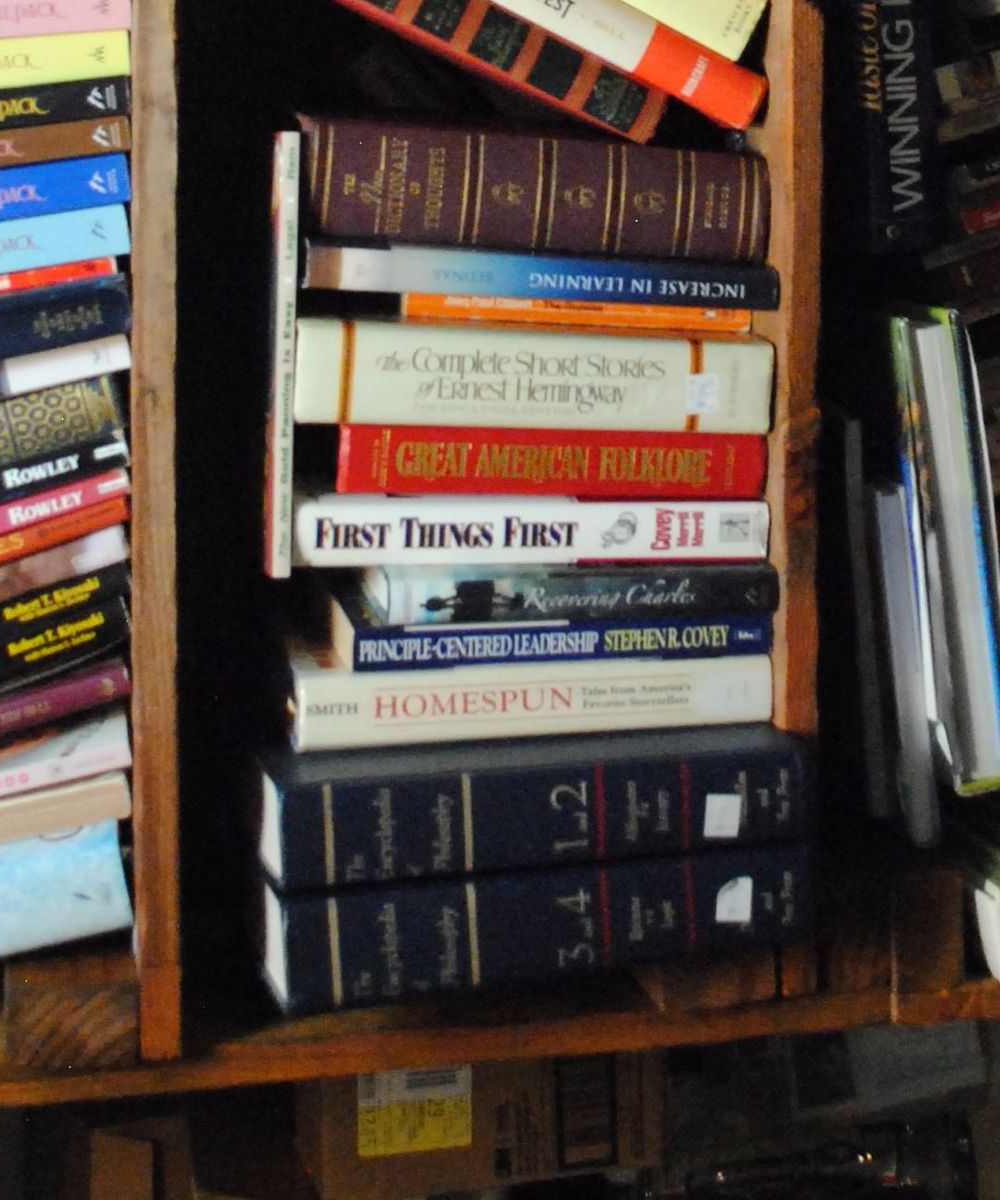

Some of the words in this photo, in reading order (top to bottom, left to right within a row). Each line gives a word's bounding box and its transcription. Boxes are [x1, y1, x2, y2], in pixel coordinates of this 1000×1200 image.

[881, 17, 924, 214] WINNING
[529, 272, 624, 294] LEARNING
[627, 275, 653, 295] IN
[659, 277, 746, 299] INCREASE
[411, 345, 510, 380] Complete
[514, 351, 581, 379] Short
[584, 354, 667, 380] Stories
[416, 379, 437, 403] of
[516, 379, 627, 415] Hemingway
[3, 455, 79, 488] ROWLEY
[395, 441, 473, 480] GREAT
[475, 443, 589, 480] AMERICAN
[599, 444, 711, 484] FOLKLORE
[8, 491, 83, 525] ROWLEY
[315, 516, 392, 550] FIRST
[400, 515, 495, 550] THINGS
[501, 516, 580, 549] FIRST
[650, 507, 676, 551] Covey
[358, 631, 512, 664] PRINCIPLE-CENTERED
[512, 629, 599, 656] LEADERSHIP
[604, 628, 667, 652] STEPHEN
[667, 628, 681, 650] R.
[681, 624, 729, 649] COVEY
[306, 701, 359, 718] SMITH
[372, 686, 574, 721] HOMESPUN
